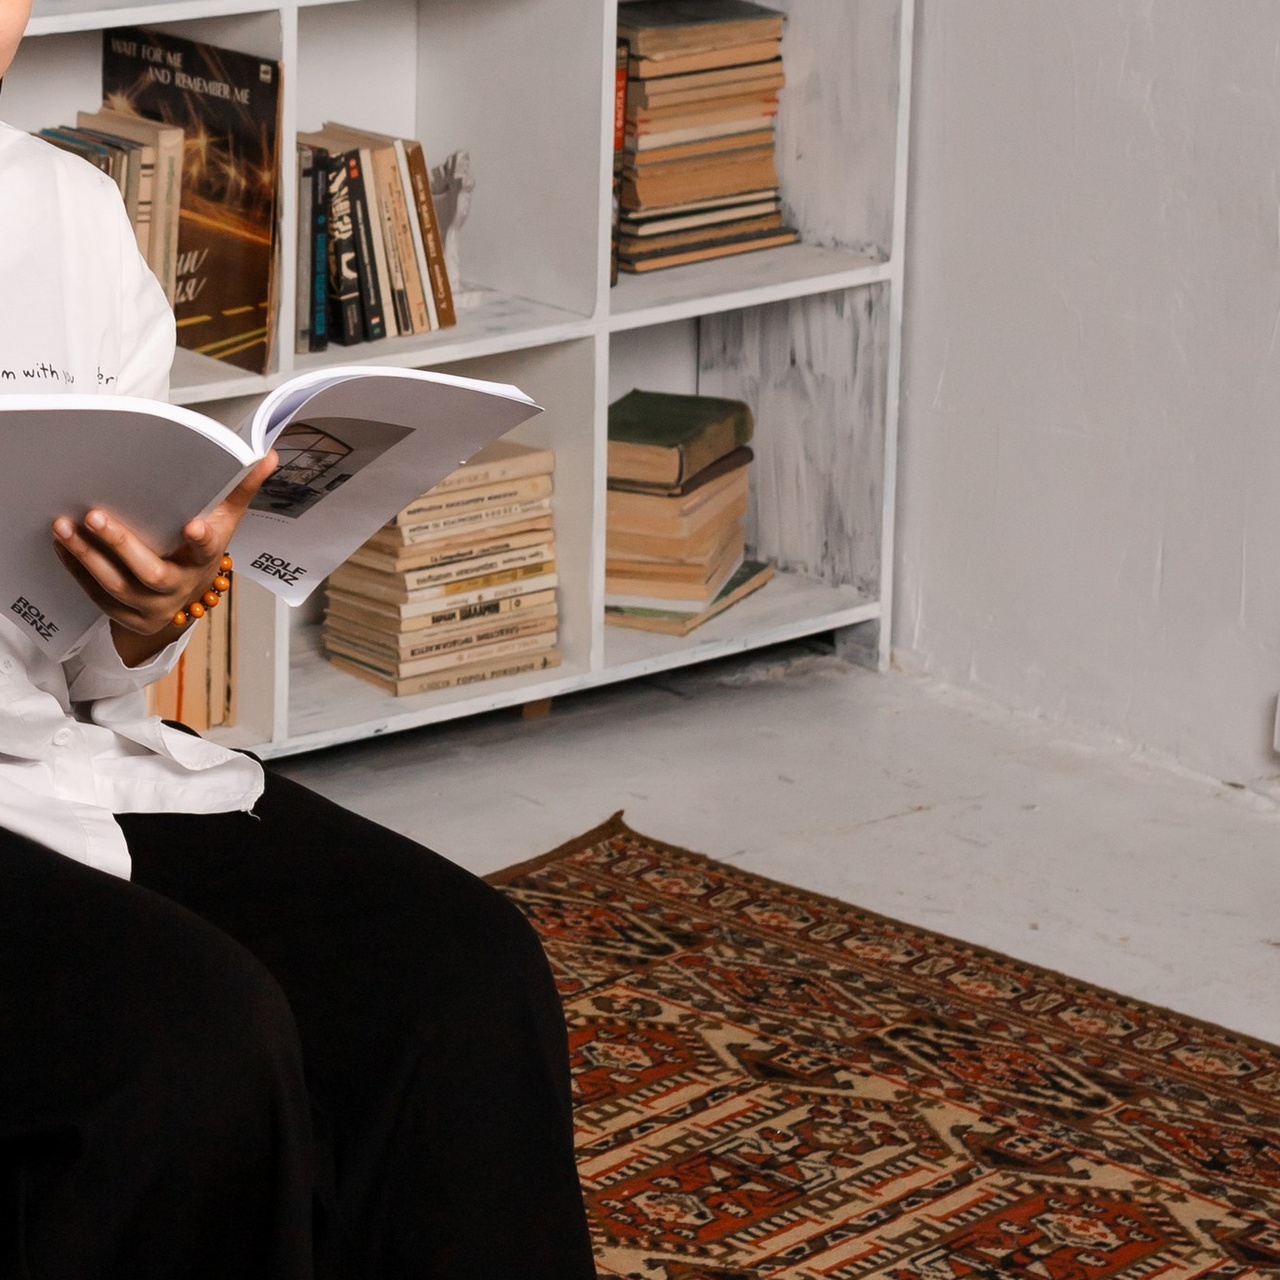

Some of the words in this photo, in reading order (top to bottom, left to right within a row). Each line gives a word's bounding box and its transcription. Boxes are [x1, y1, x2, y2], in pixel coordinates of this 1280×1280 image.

[110, 38, 137, 57] WAIT
[141, 46, 163, 64] FOR
[166, 52, 183, 68] ME
[148, 65, 170, 85] AND
[174, 71, 230, 100] REMEMBER
[233, 87, 251, 105] ME
[22, 362, 59, 380] with
[250, 559, 299, 586] BENZ
[258, 552, 307, 575] ROLF
[10, 602, 53, 641] BENZ
[16, 596, 59, 632] ROLF
